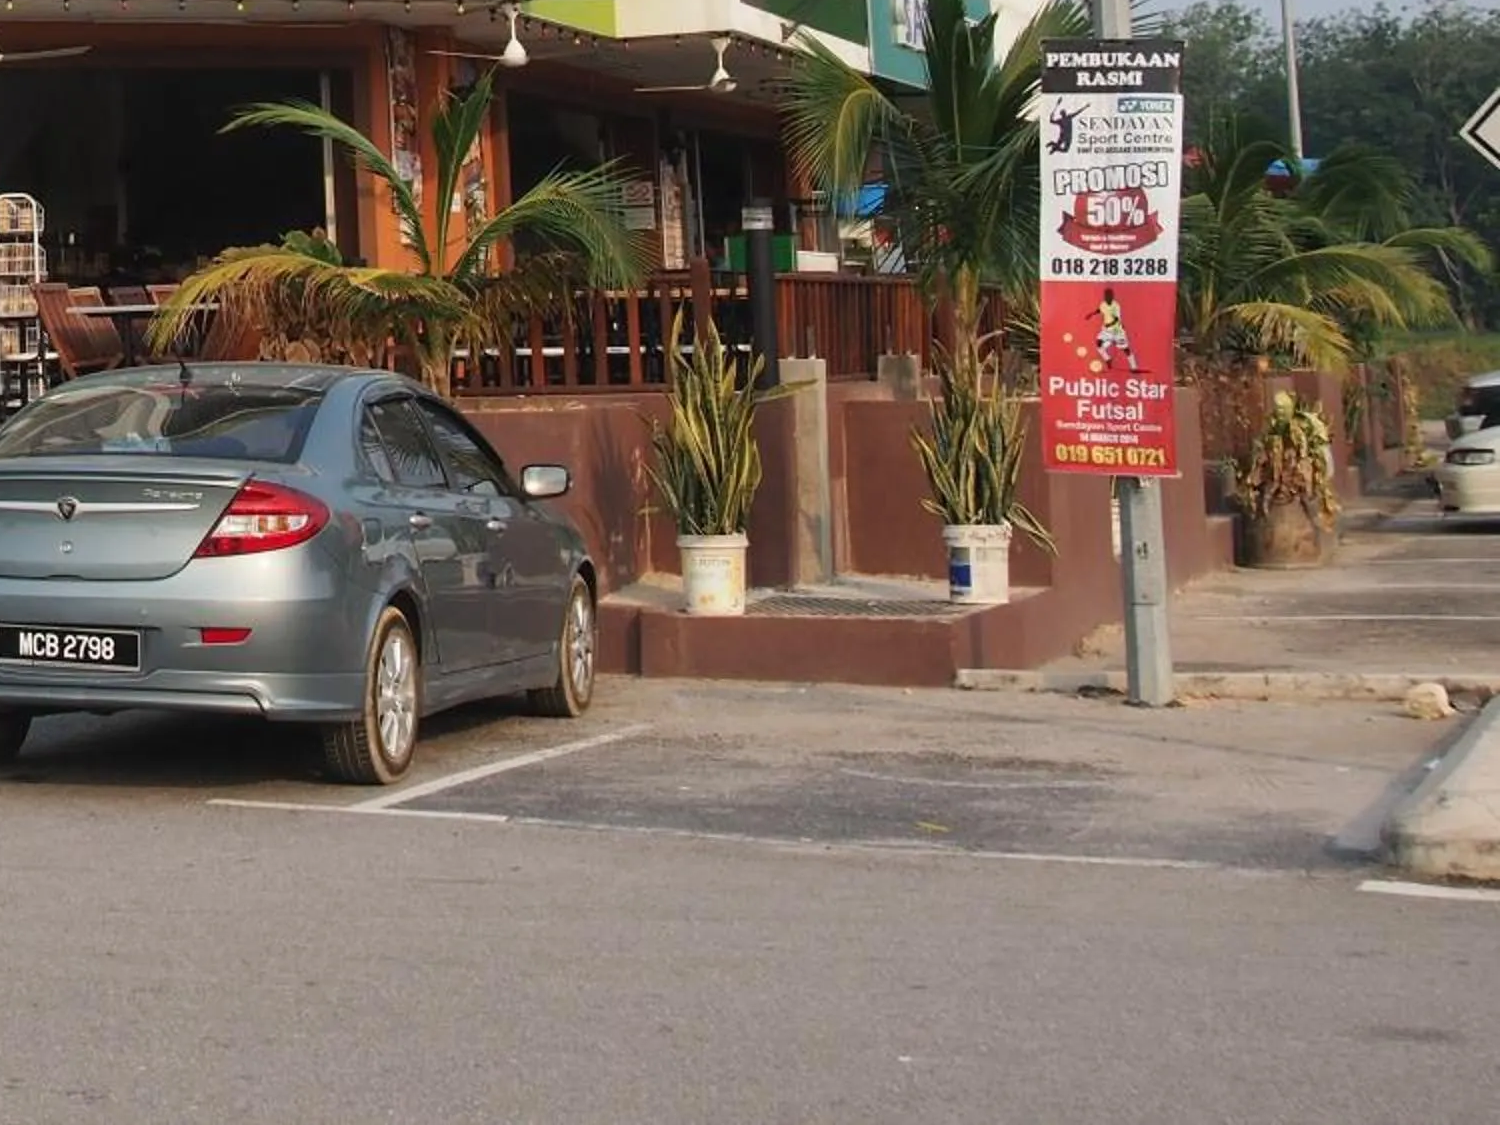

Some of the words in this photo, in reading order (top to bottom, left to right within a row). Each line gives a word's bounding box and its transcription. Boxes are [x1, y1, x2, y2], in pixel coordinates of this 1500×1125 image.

[1046, 52, 1180, 68] PEMBUKAAN
[1076, 72, 1143, 86] RASMI
[1078, 116, 1174, 130] SENDAYAN
[1077, 132, 1118, 148] Sport
[1123, 132, 1173, 144] Centre
[1054, 162, 1169, 195] PROMOSI
[1087, 196, 1146, 227] 50%
[1052, 259, 1083, 275] 018
[1090, 259, 1119, 275] 218
[1124, 259, 1168, 275] 3288
[1049, 376, 1120, 398] Public
[1125, 379, 1169, 400] Star
[1076, 400, 1143, 421] Futsal
[1055, 443, 1089, 463] 019
[1091, 445, 1124, 465] 651
[1126, 446, 1165, 466] 0721
[18, 630, 61, 658] MCB
[63, 633, 116, 662] 2798
